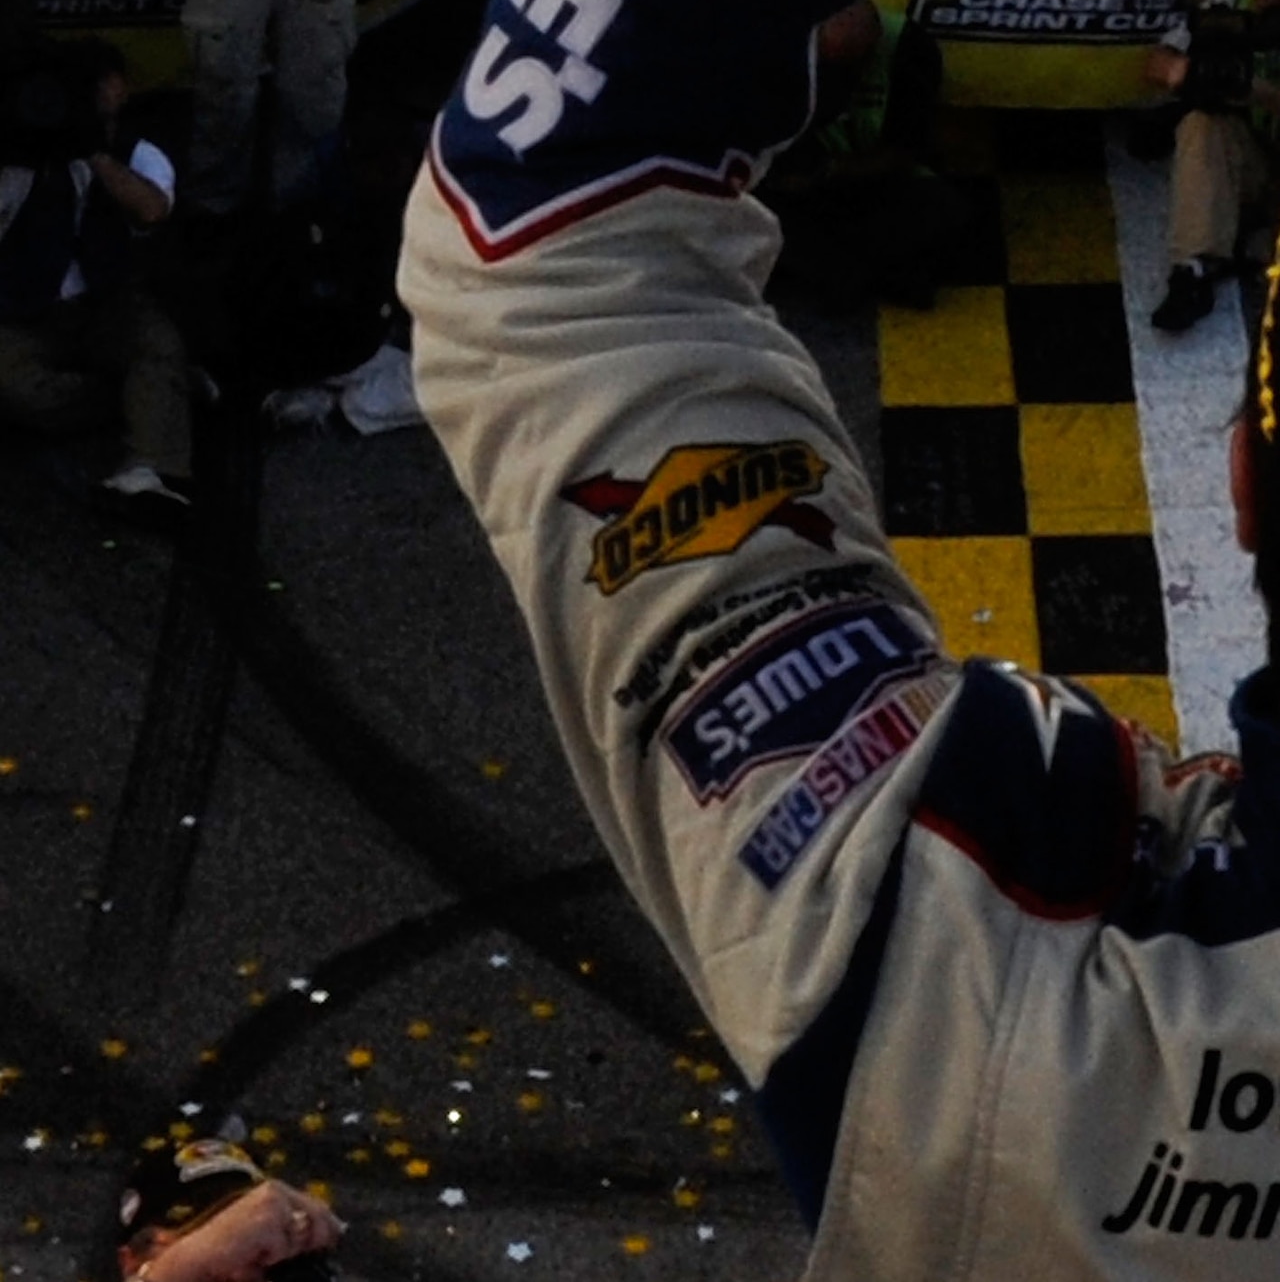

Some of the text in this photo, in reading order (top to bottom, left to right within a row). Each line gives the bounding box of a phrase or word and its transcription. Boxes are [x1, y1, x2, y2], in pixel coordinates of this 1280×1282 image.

[930, 8, 1097, 31] SPRINT
[603, 445, 811, 578] SUNOCO
[693, 617, 900, 761] LOWE'S
[757, 723, 898, 875] NASCAR
